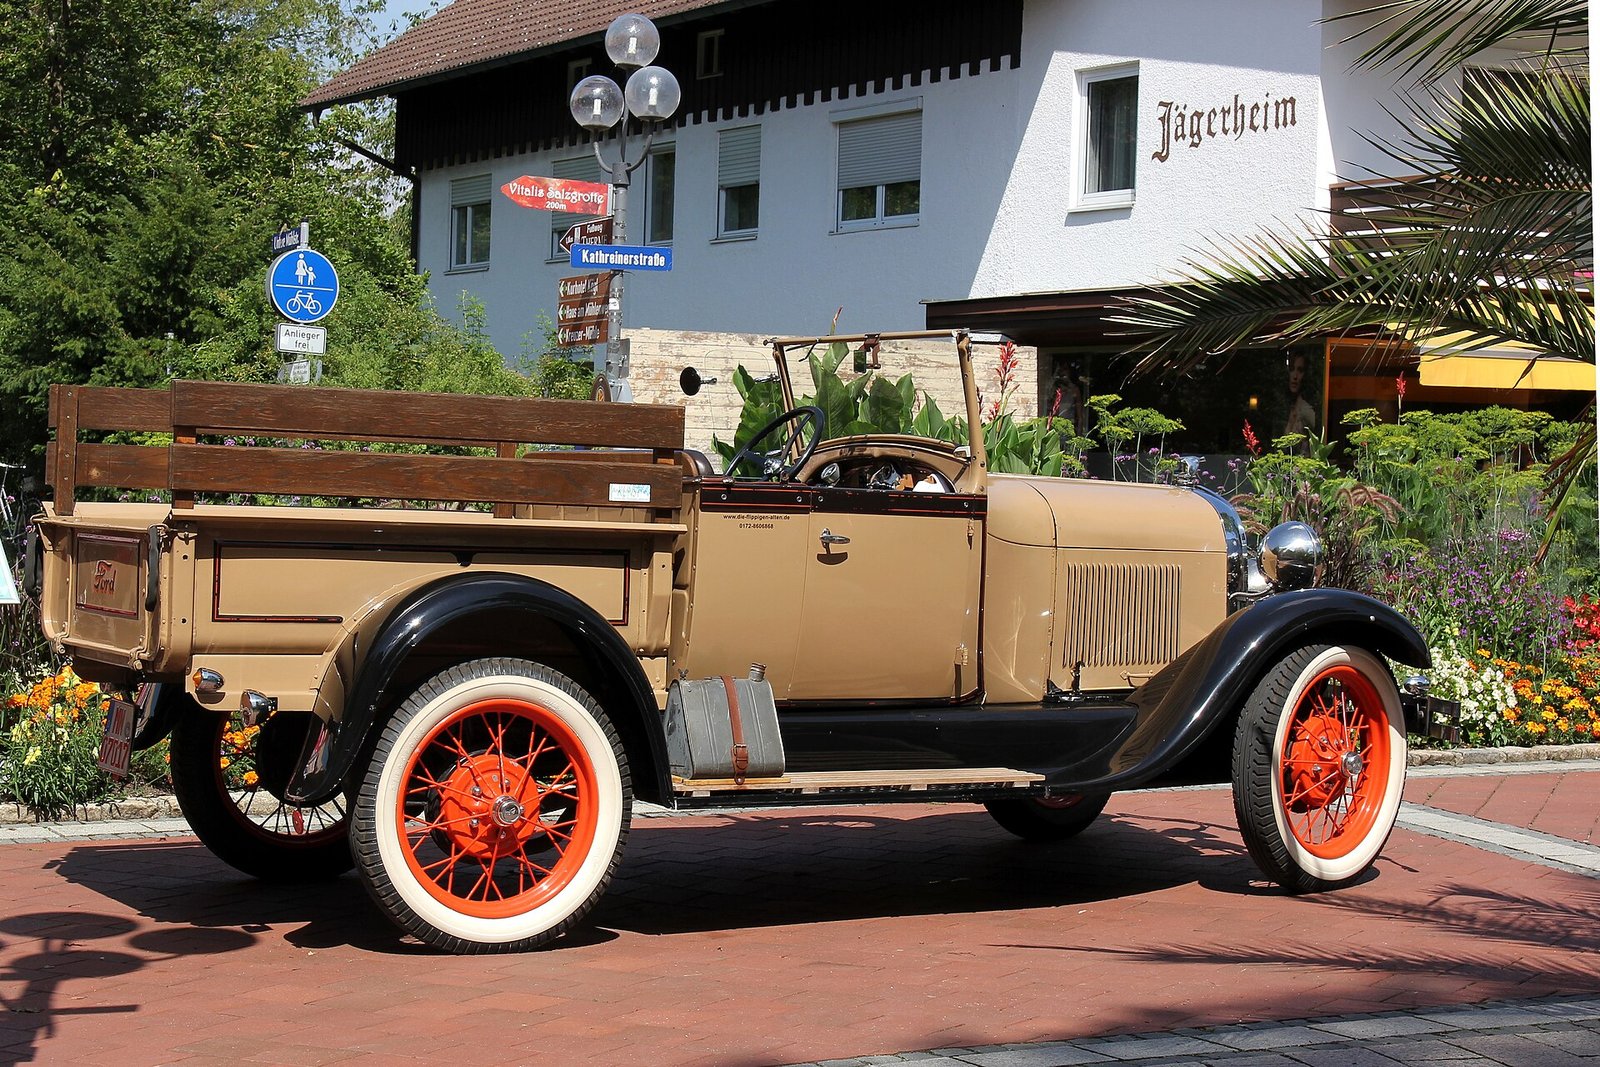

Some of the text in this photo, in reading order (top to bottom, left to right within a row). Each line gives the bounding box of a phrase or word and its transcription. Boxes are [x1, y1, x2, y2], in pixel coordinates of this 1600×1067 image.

[1151, 93, 1298, 164] Jägerheim
[508, 183, 605, 204] Vitalis Salzgrotte
[545, 201, 567, 210] 200m
[582, 249, 666, 267] Kathreinerstraße
[284, 328, 320, 341] Anlieger
[294, 339, 310, 350] frei
[94, 560, 117, 594] Ford
